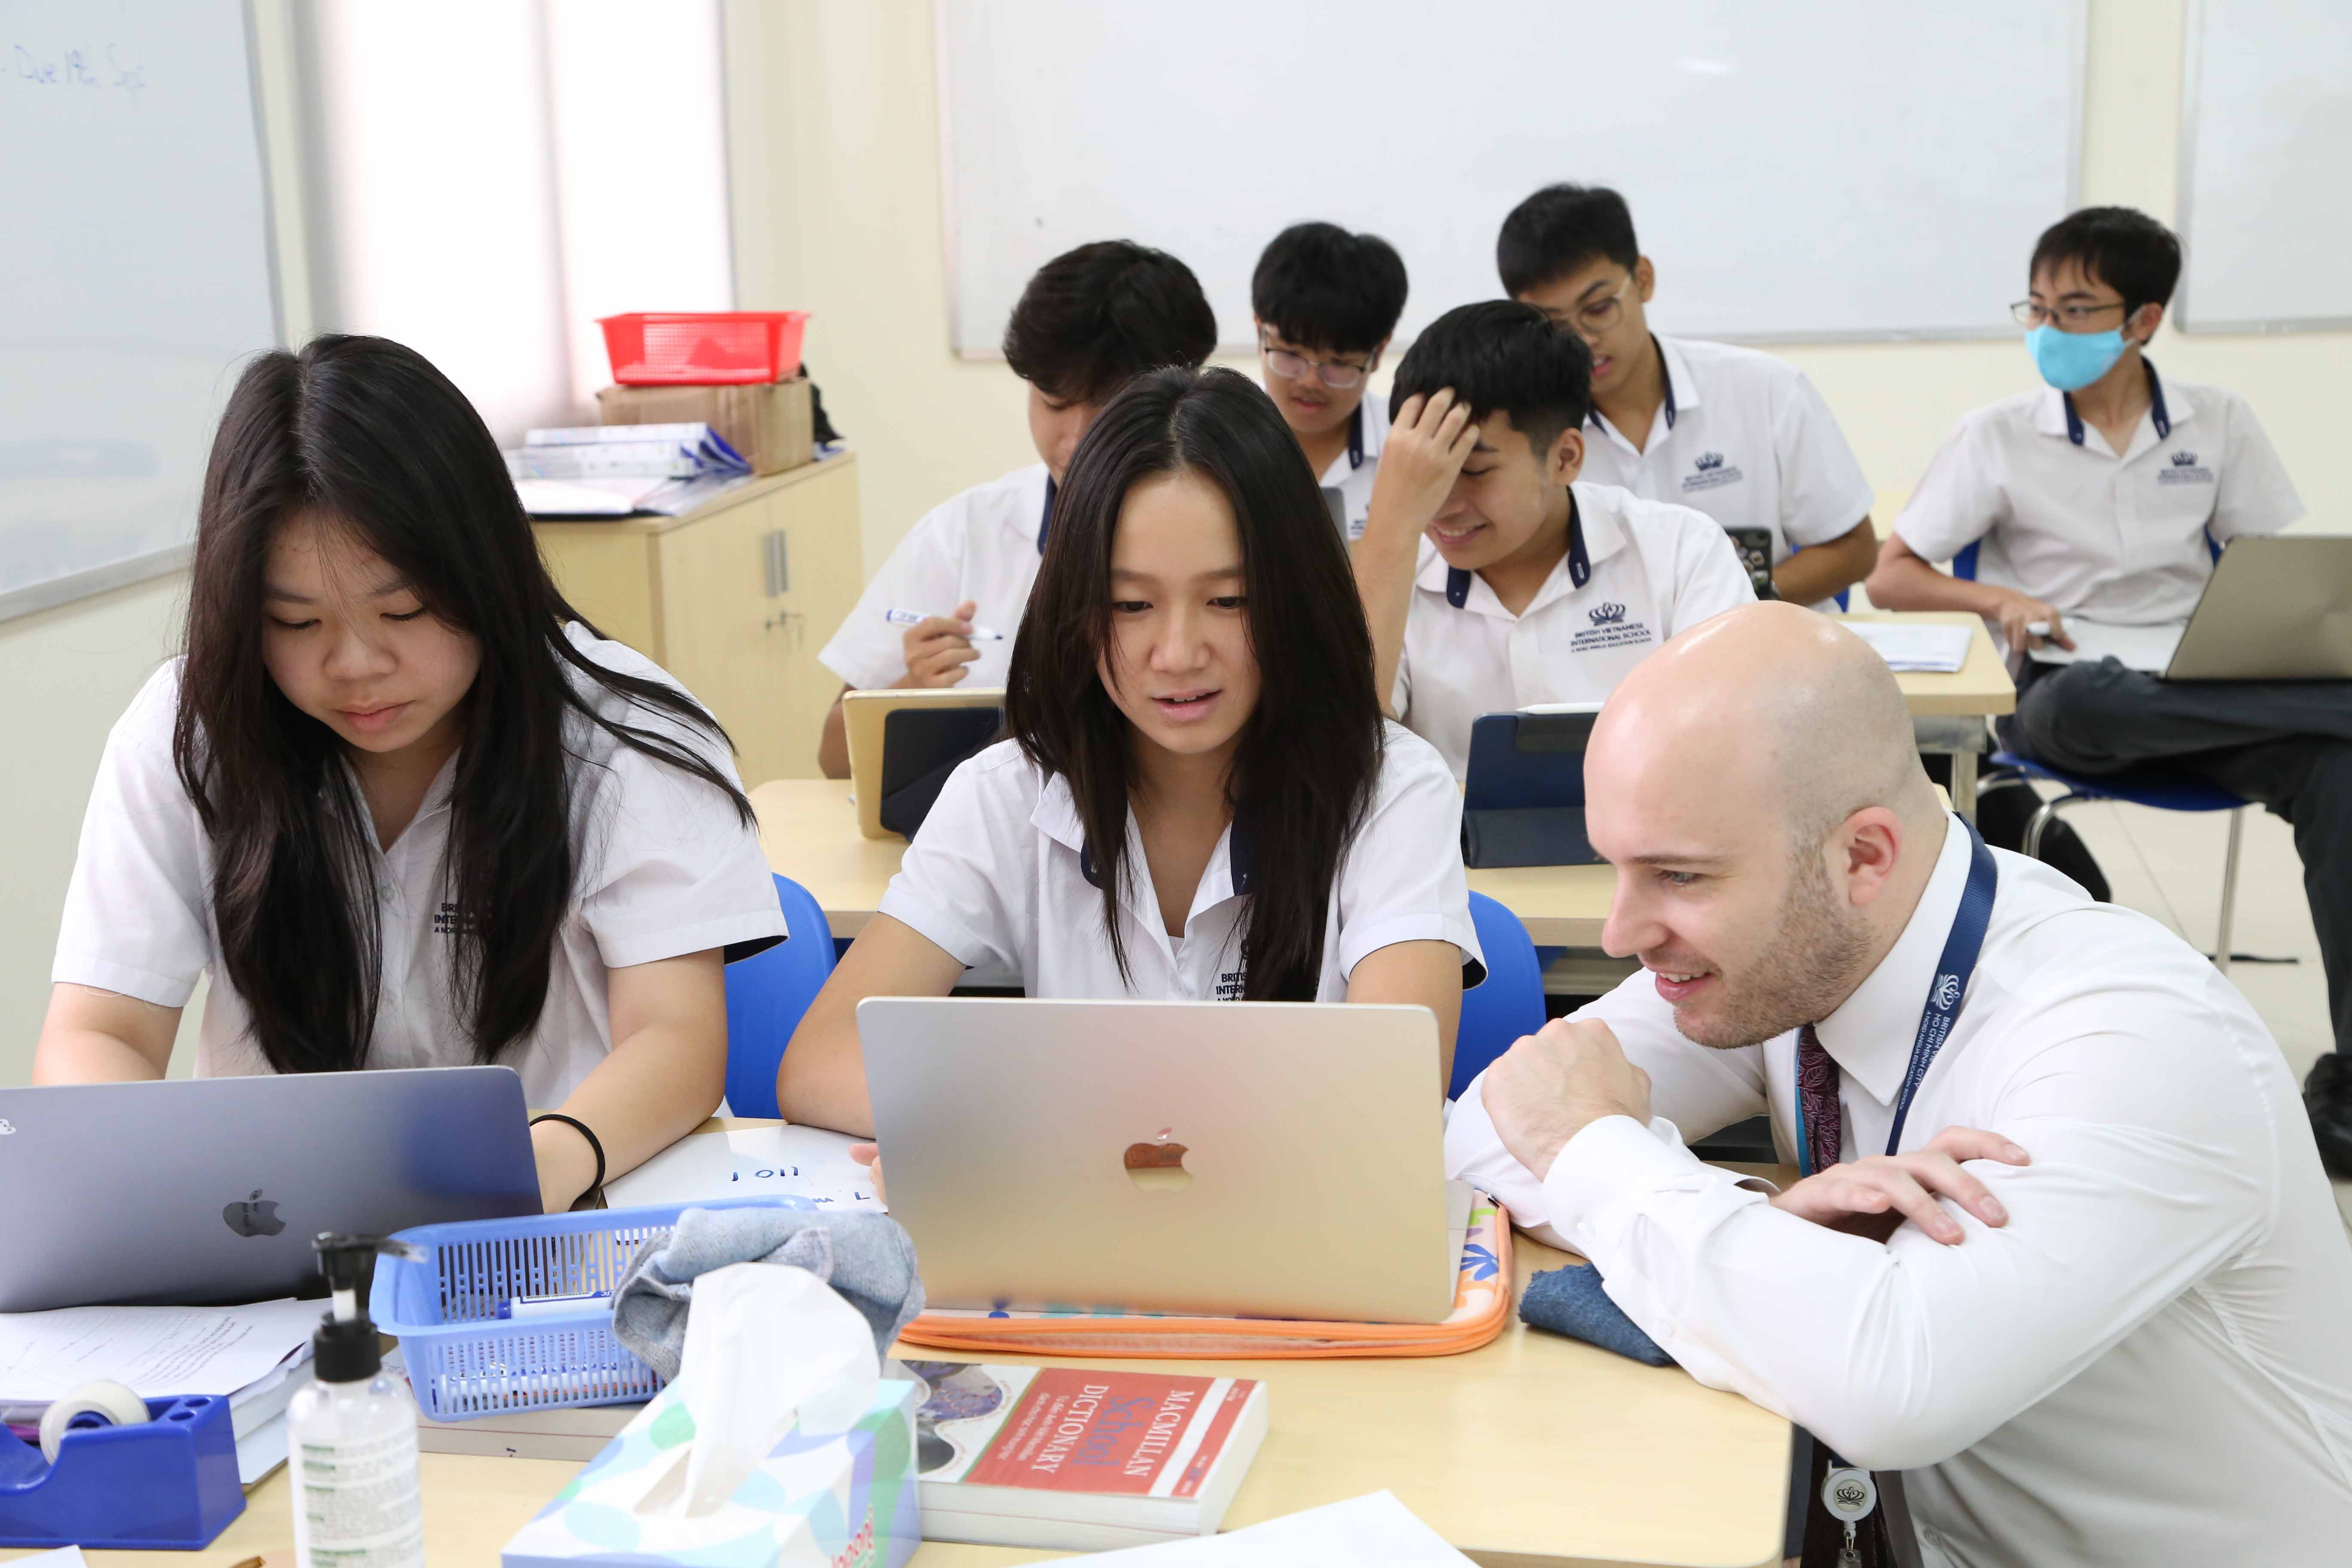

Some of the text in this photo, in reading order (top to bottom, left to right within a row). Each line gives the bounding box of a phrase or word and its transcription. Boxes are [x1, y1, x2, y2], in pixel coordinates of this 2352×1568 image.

[1571, 630, 1650, 646] INTERNATIONAL SCHOOL
[1602, 623, 1643, 633] VIETNAMESE
[1922, 1016, 1930, 1033] NORD
[1935, 1017, 1950, 1048] BRITISH
[1914, 1013, 1942, 1088] HO CHI MINH CITY
[1915, 1034, 1925, 1054] ANGLIA
[1906, 1055, 1919, 1087] EDUCATION
[1031, 1384, 1109, 1473] DICTIONARY
[1073, 1396, 1155, 1466] School
[1122, 1390, 1195, 1476] MACMILLAN
